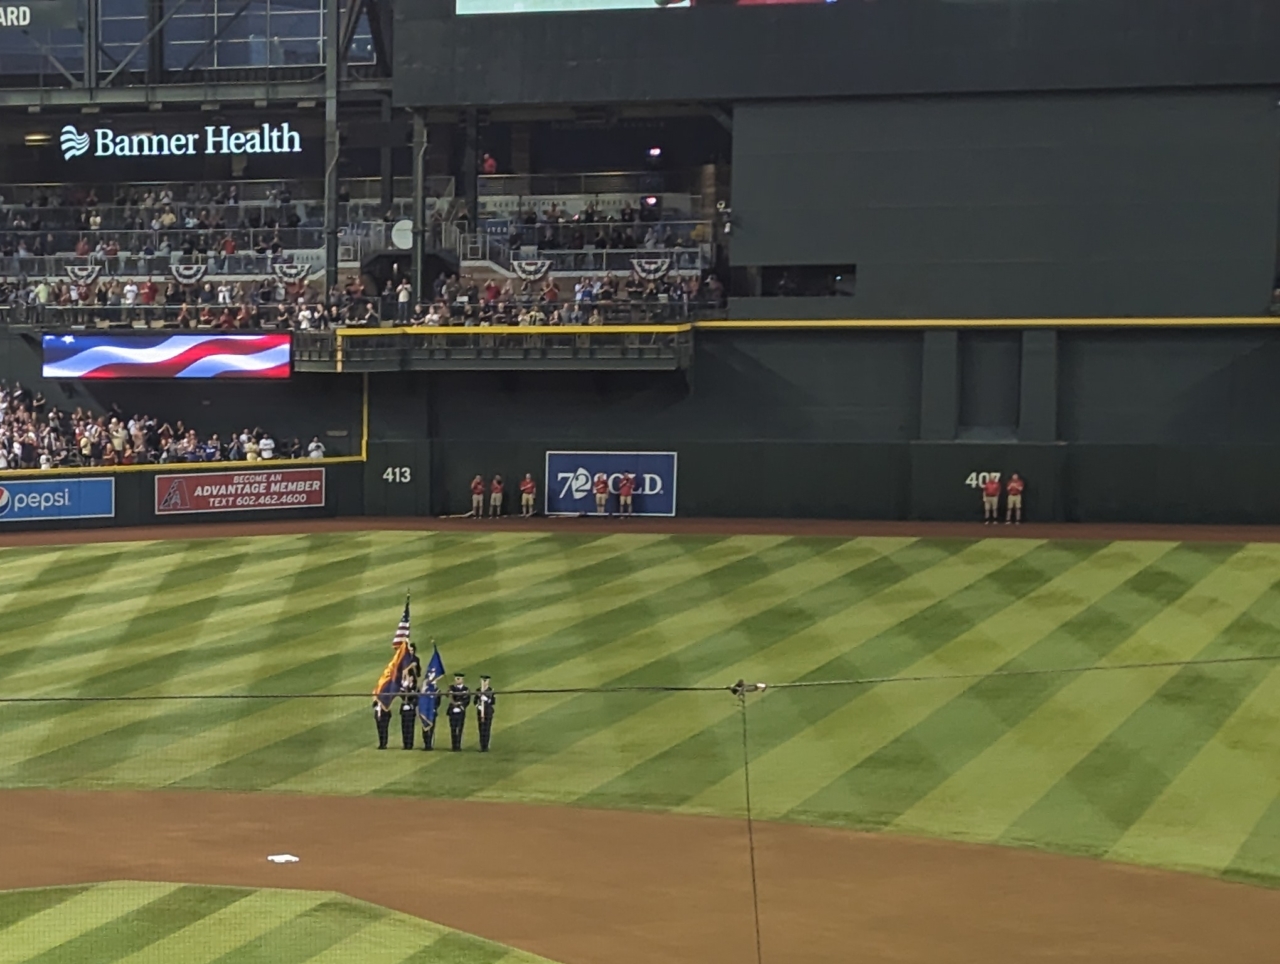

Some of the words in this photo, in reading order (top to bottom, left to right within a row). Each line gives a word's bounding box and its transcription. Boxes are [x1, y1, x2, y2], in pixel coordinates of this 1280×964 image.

[94, 128, 200, 156] Banner
[204, 122, 302, 154] Health
[233, 474, 267, 484] BECOME
[269, 473, 283, 482] AN
[382, 467, 412, 483] 413
[194, 482, 267, 497] ADVANTAGE
[270, 480, 321, 493] MEMBER
[14, 488, 70, 512] pepsi
[209, 496, 234, 507] TEXT
[236, 493, 307, 506] 602.462.4600
